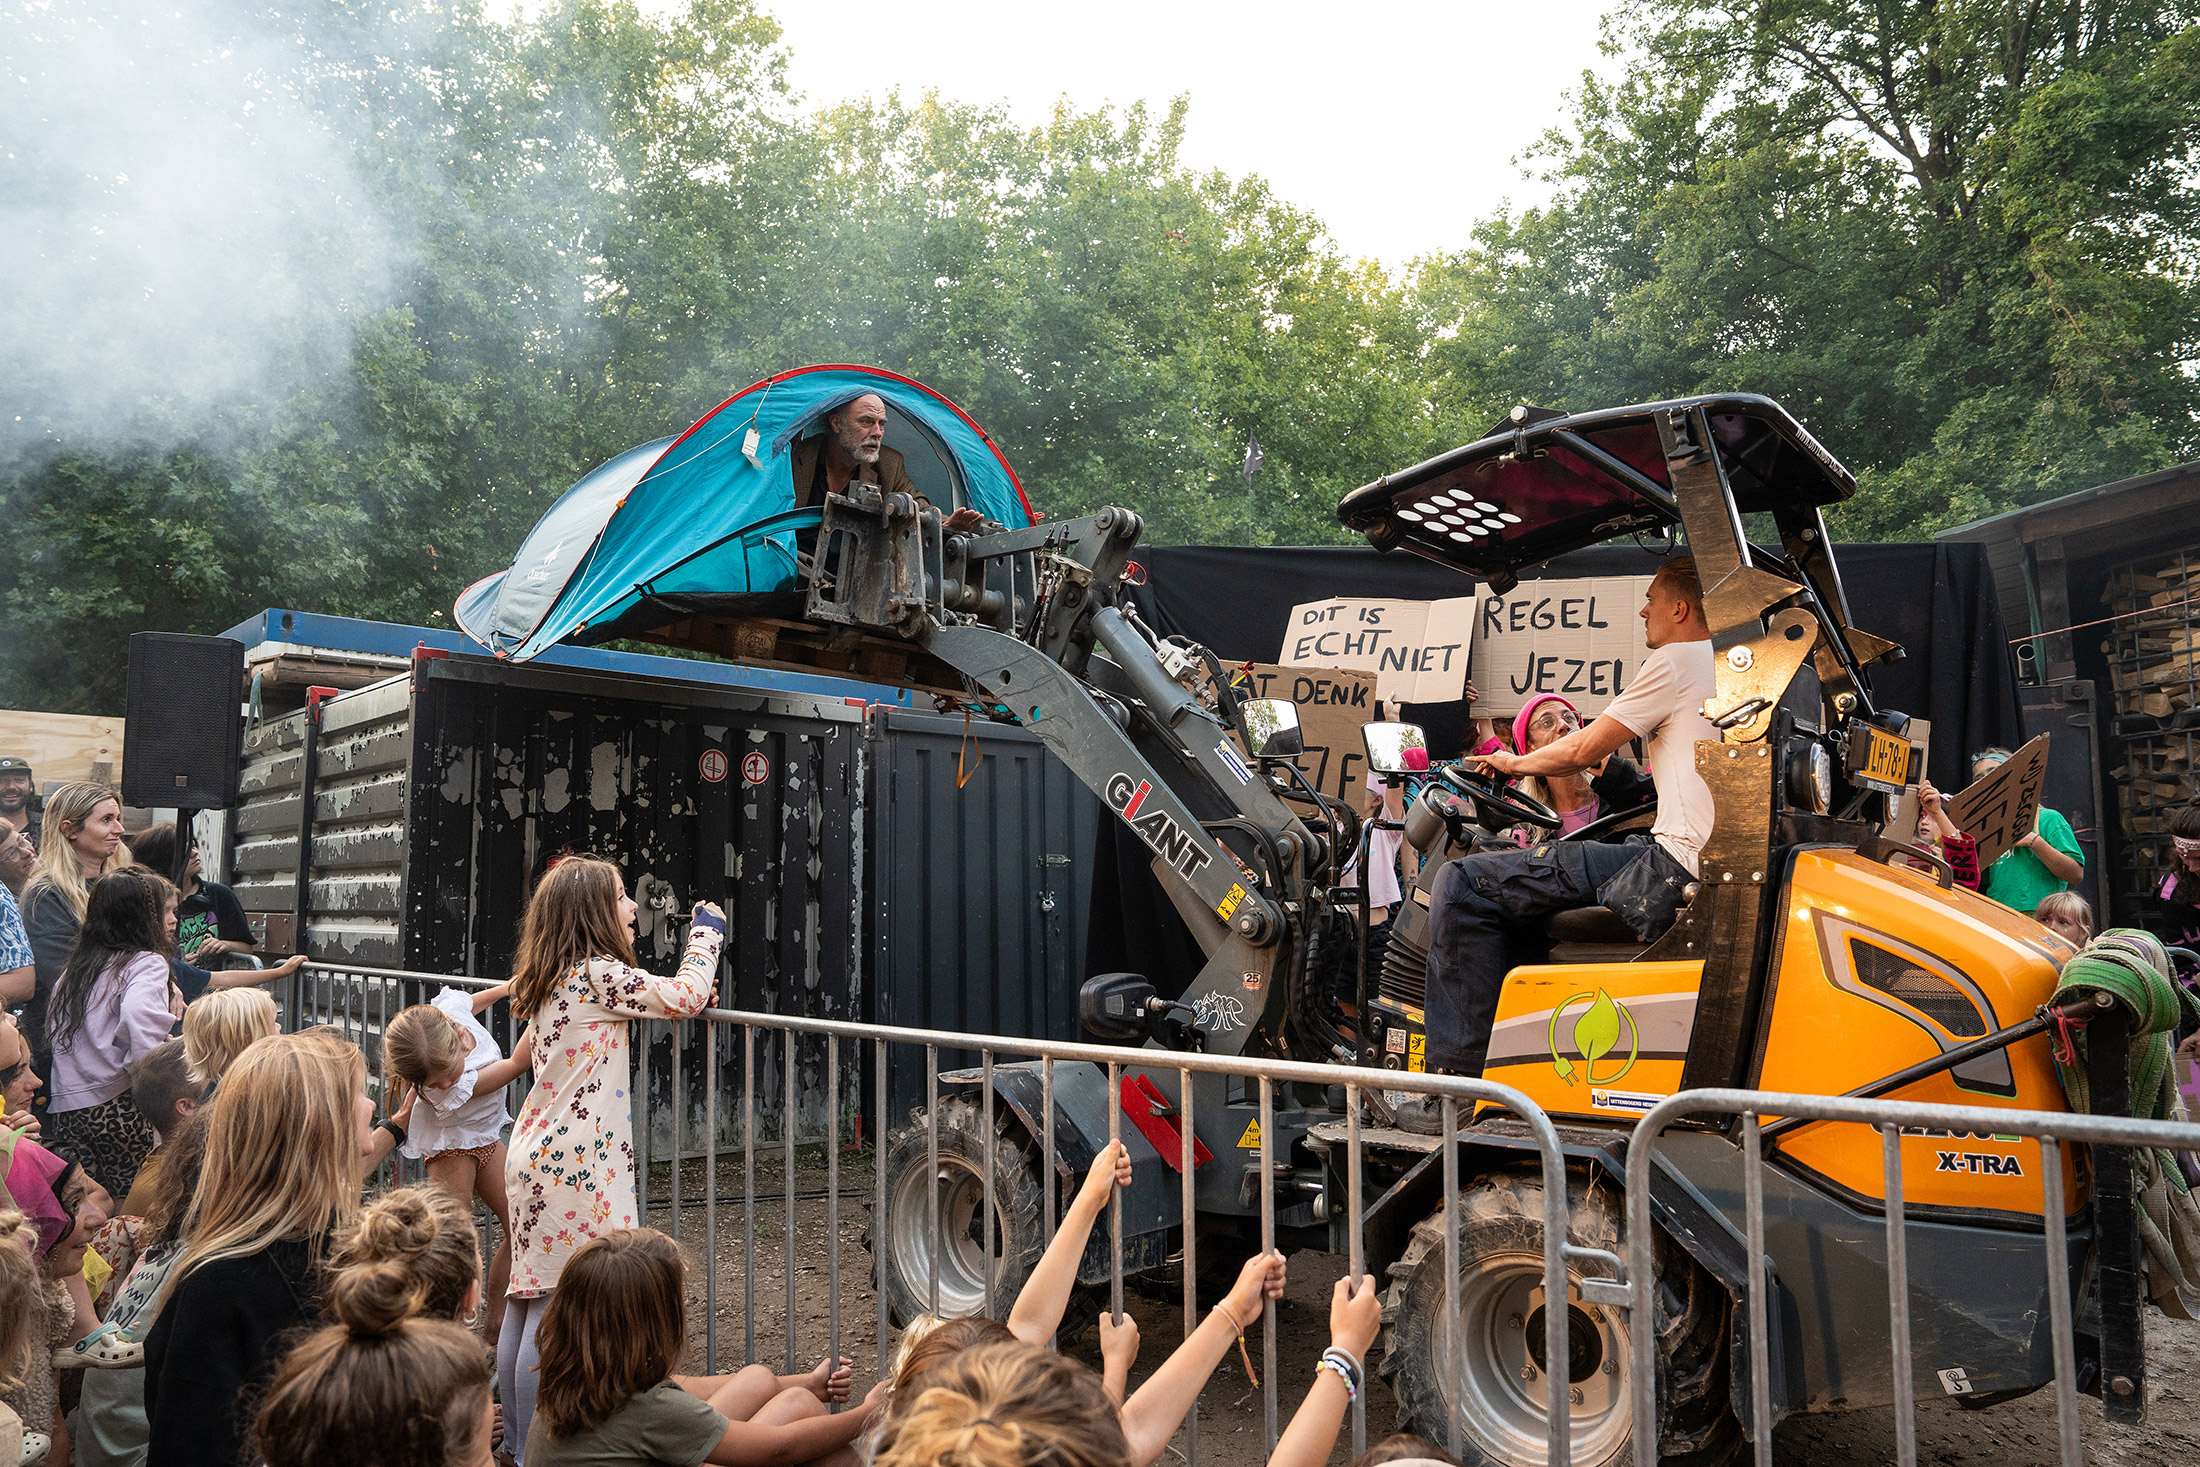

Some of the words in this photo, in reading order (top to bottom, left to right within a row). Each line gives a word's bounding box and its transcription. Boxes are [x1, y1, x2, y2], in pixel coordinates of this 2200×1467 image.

[1303, 605, 1347, 626] DIT
[1359, 607, 1386, 625] IS
[1482, 595, 1609, 639] REGEL
[1293, 629, 1392, 661] ECHT
[1379, 643, 1462, 673] NIET
[1510, 651, 1647, 697] JEZEL
[1292, 676, 1369, 709] DENK
[2020, 750, 2044, 785] WIJ
[1246, 973, 1259, 983] 25
[1935, 1150, 2025, 1177] X-TRA
